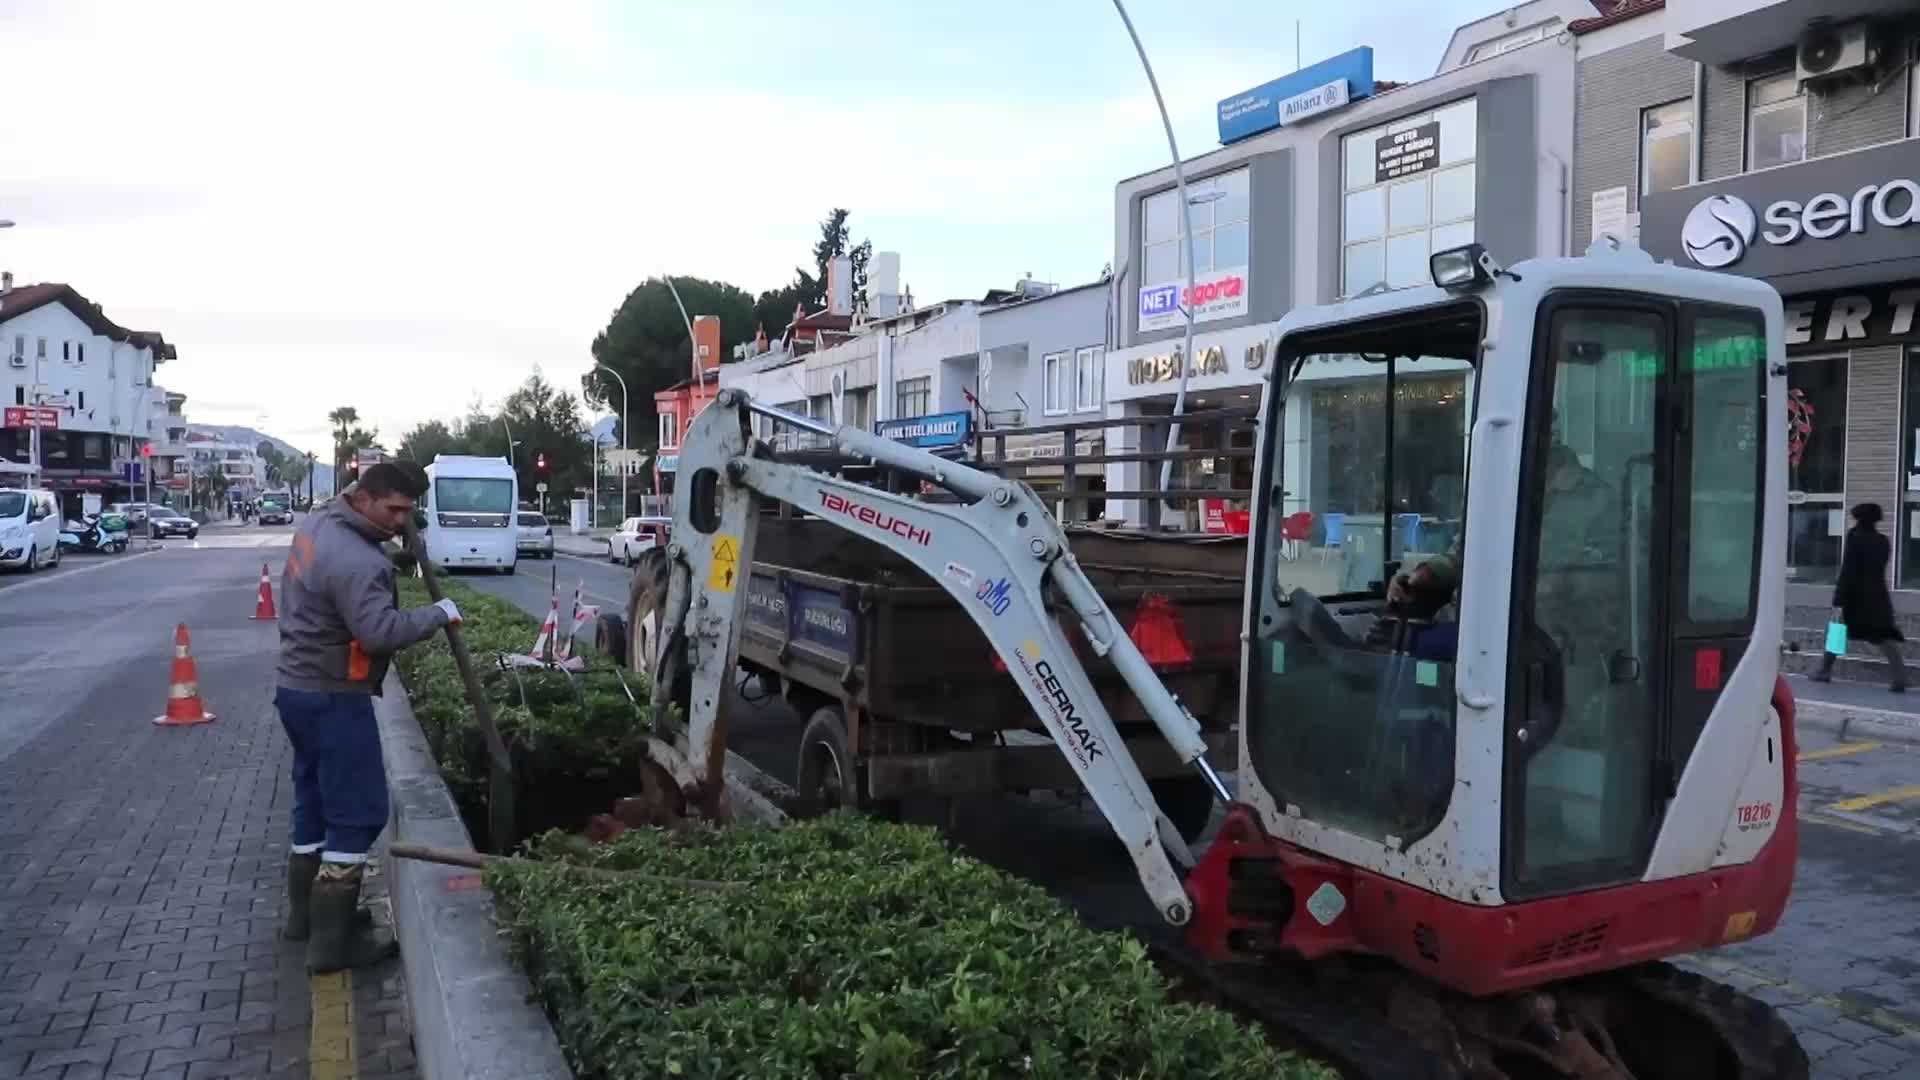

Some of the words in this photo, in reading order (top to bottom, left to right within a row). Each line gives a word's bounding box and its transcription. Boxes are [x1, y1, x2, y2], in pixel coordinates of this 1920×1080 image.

[1286, 95, 1320, 115] Allianz
[1143, 290, 1174, 311] NET
[1182, 275, 1243, 306] Sgorta
[926, 420, 957, 437] MARKET
[1035, 660, 1103, 762] CERMAK
[1737, 803, 1772, 824] TB216
